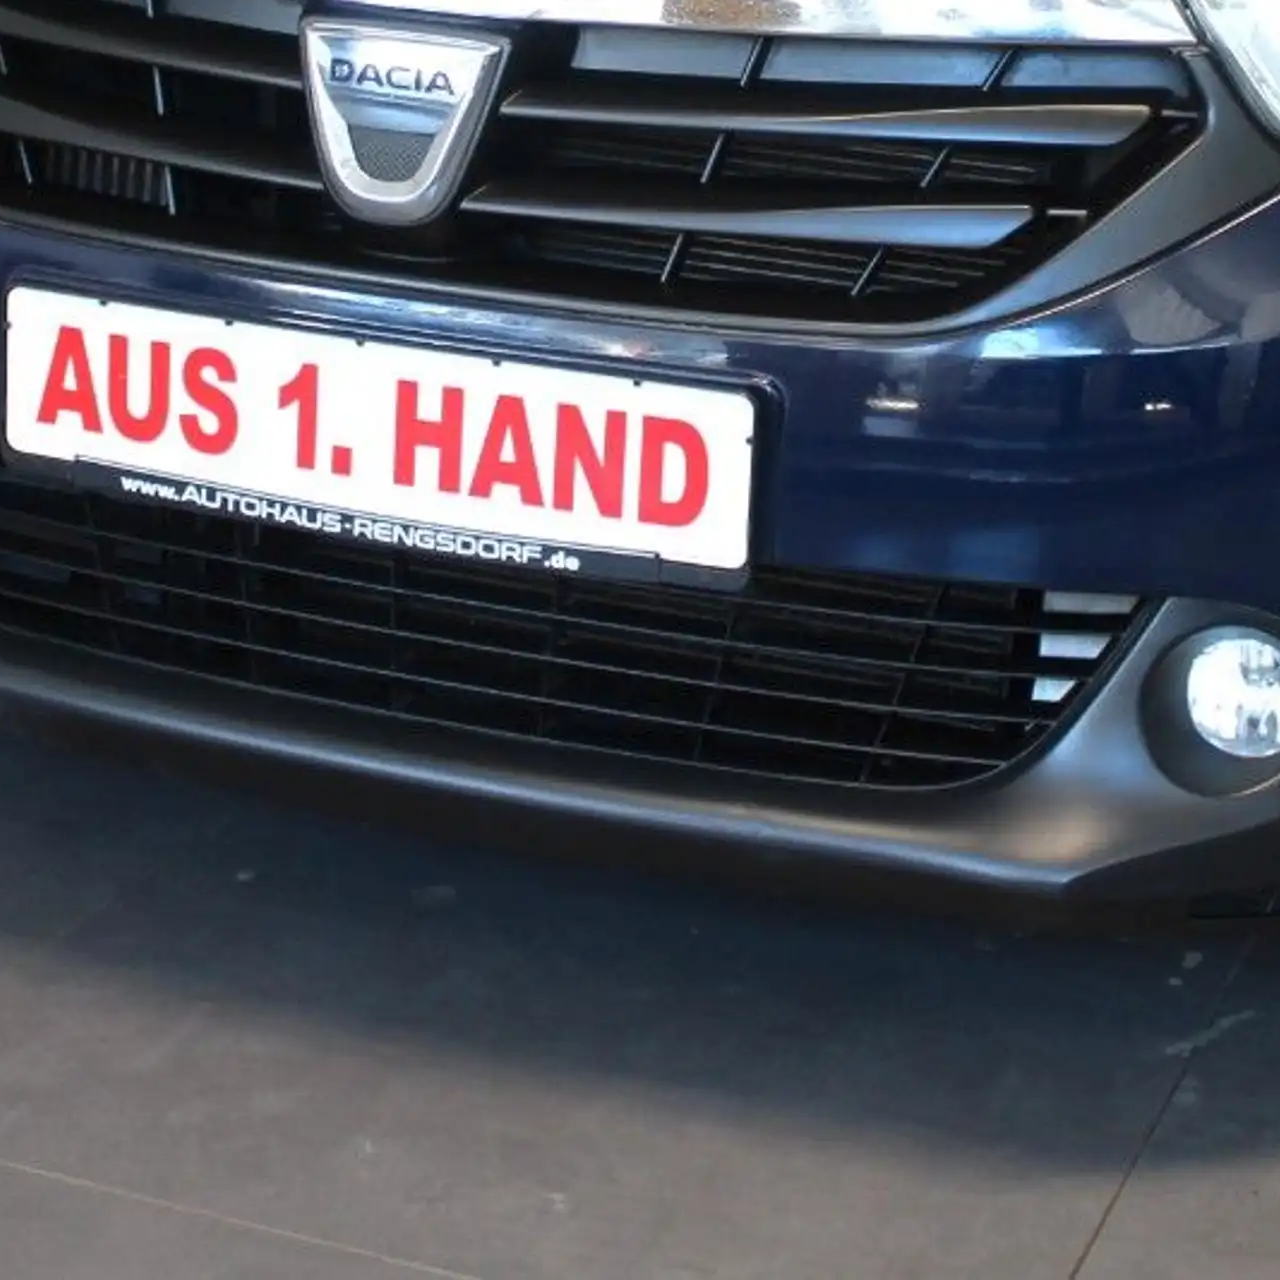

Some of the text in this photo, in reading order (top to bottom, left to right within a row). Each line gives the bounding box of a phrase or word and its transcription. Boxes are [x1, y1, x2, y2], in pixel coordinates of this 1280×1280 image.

[330, 57, 455, 96] DACIA
[36, 325, 710, 528] AUS 1. HAND
